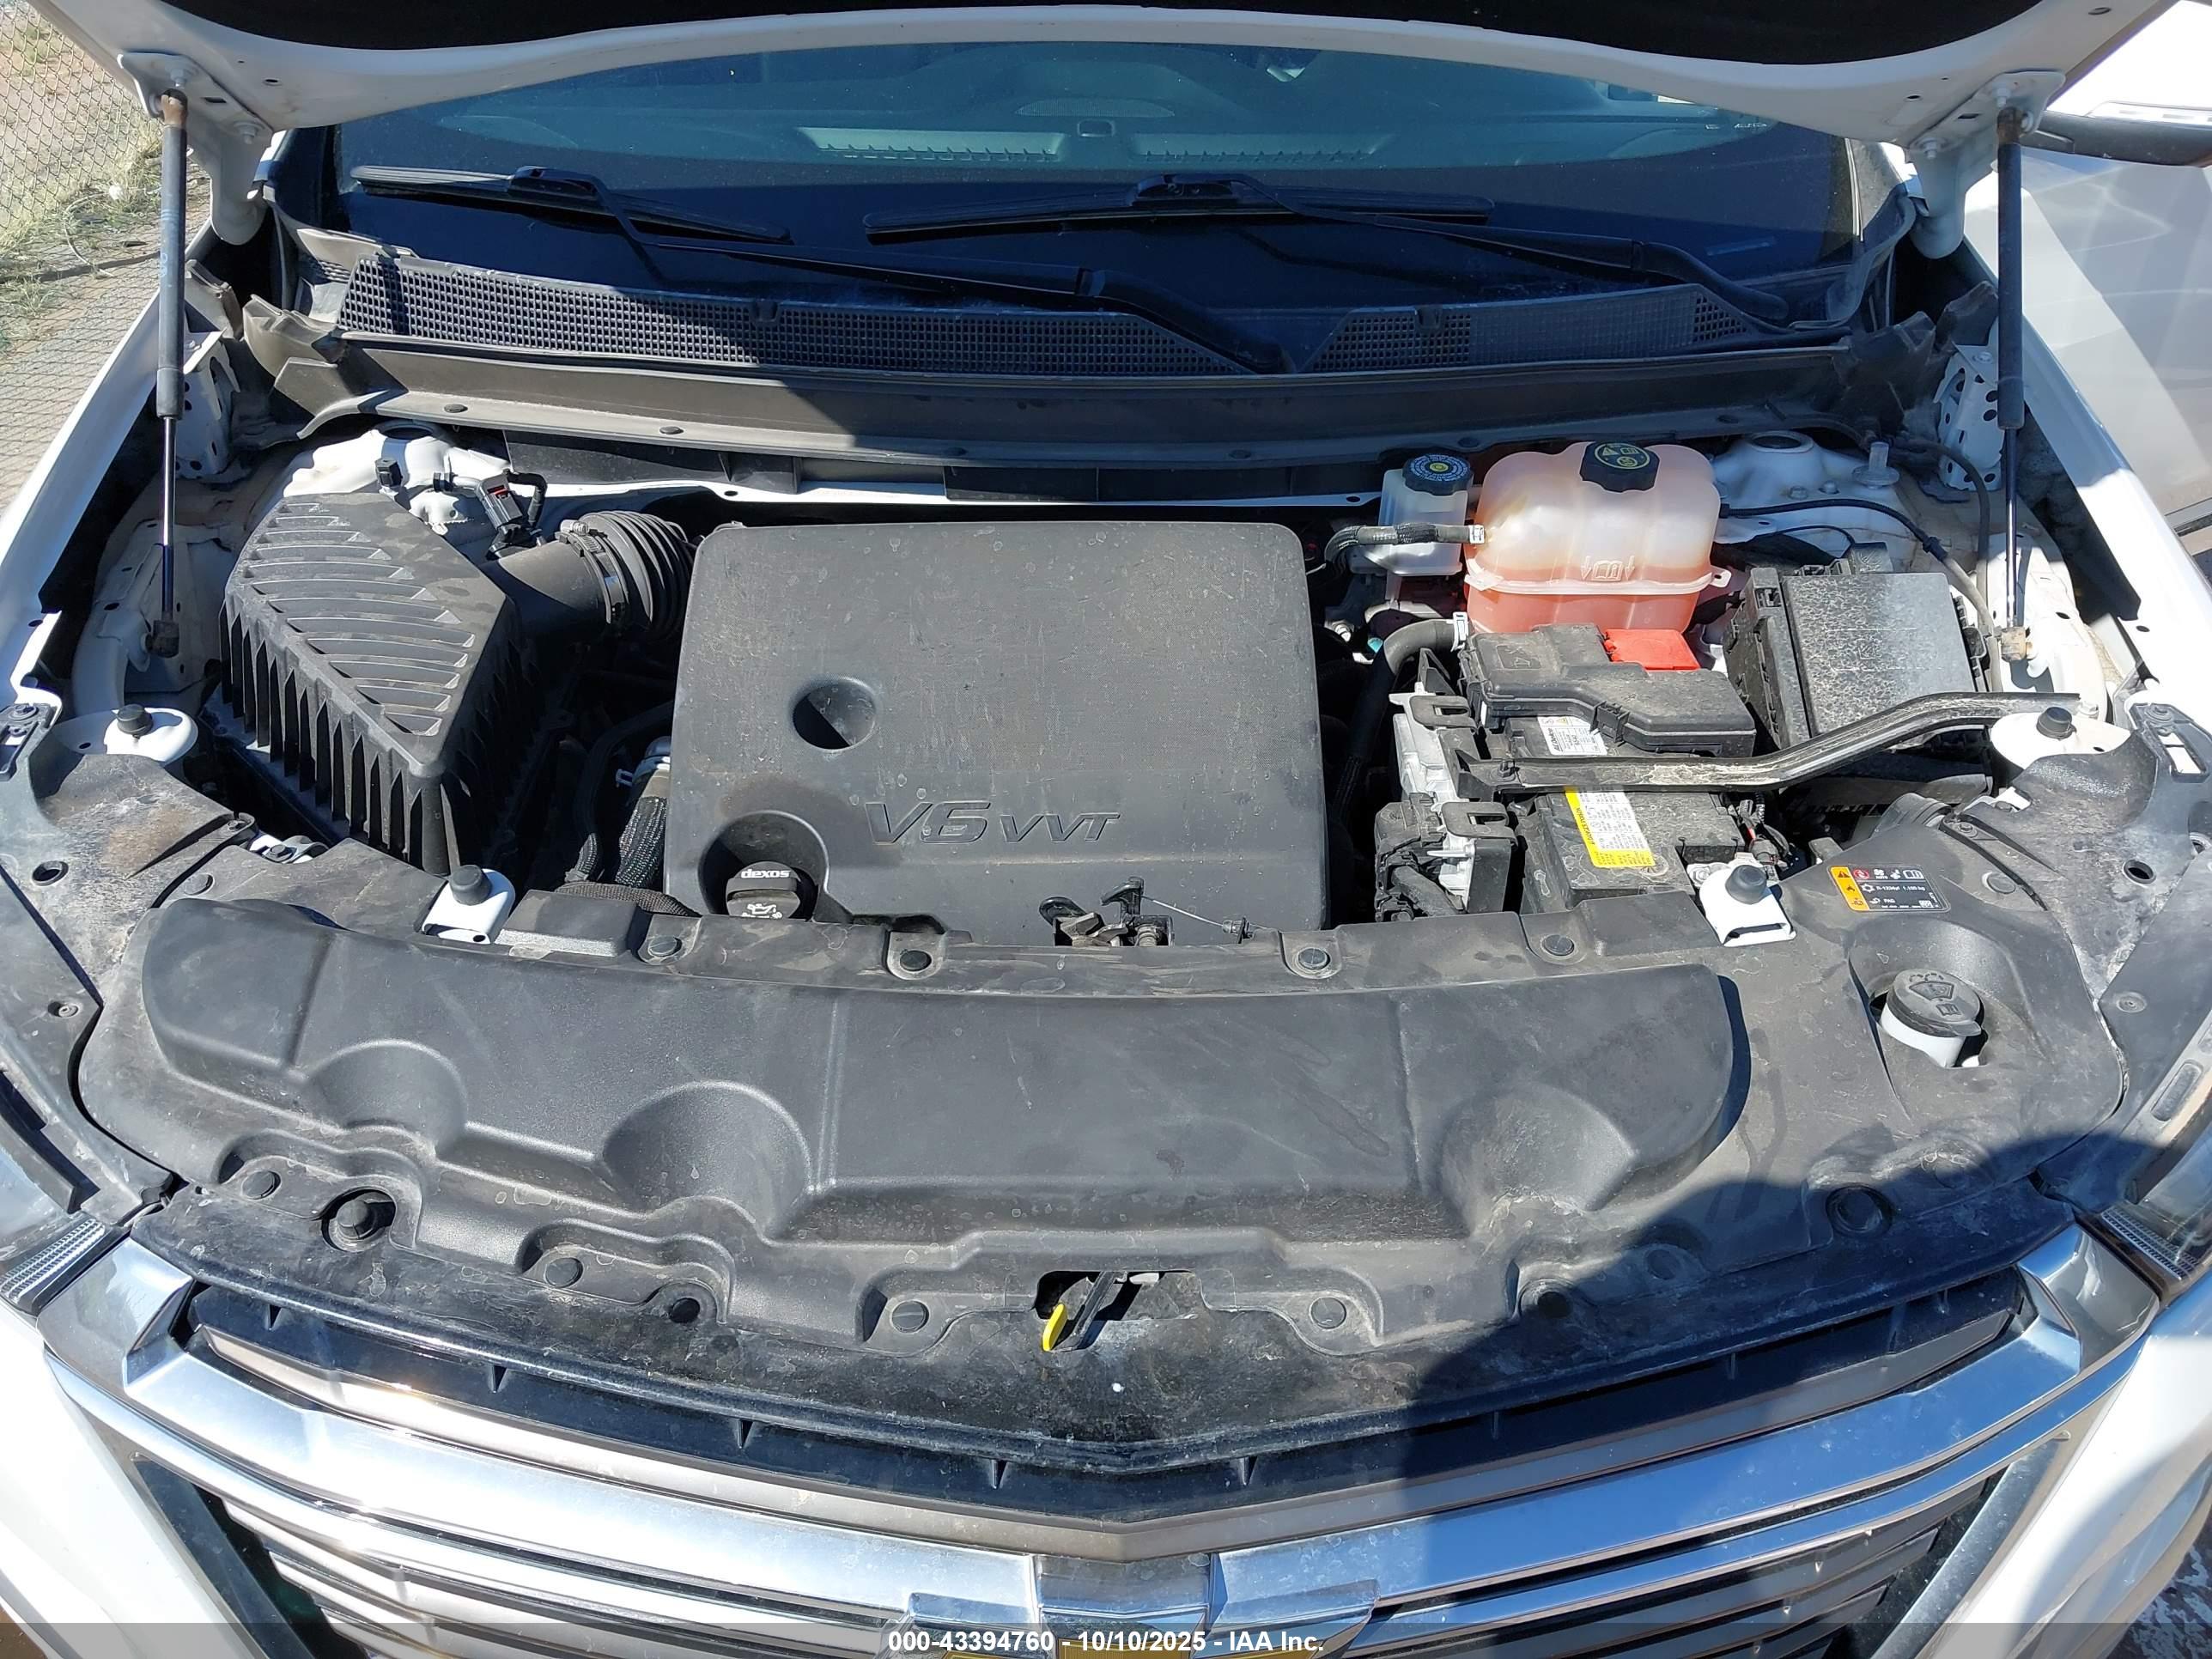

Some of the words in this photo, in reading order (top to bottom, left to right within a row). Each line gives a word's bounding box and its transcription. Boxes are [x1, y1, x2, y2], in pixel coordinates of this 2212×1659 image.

[865, 800, 991, 845] V6
[1000, 812, 1121, 842] VVT
[741, 868, 791, 878] dexos
